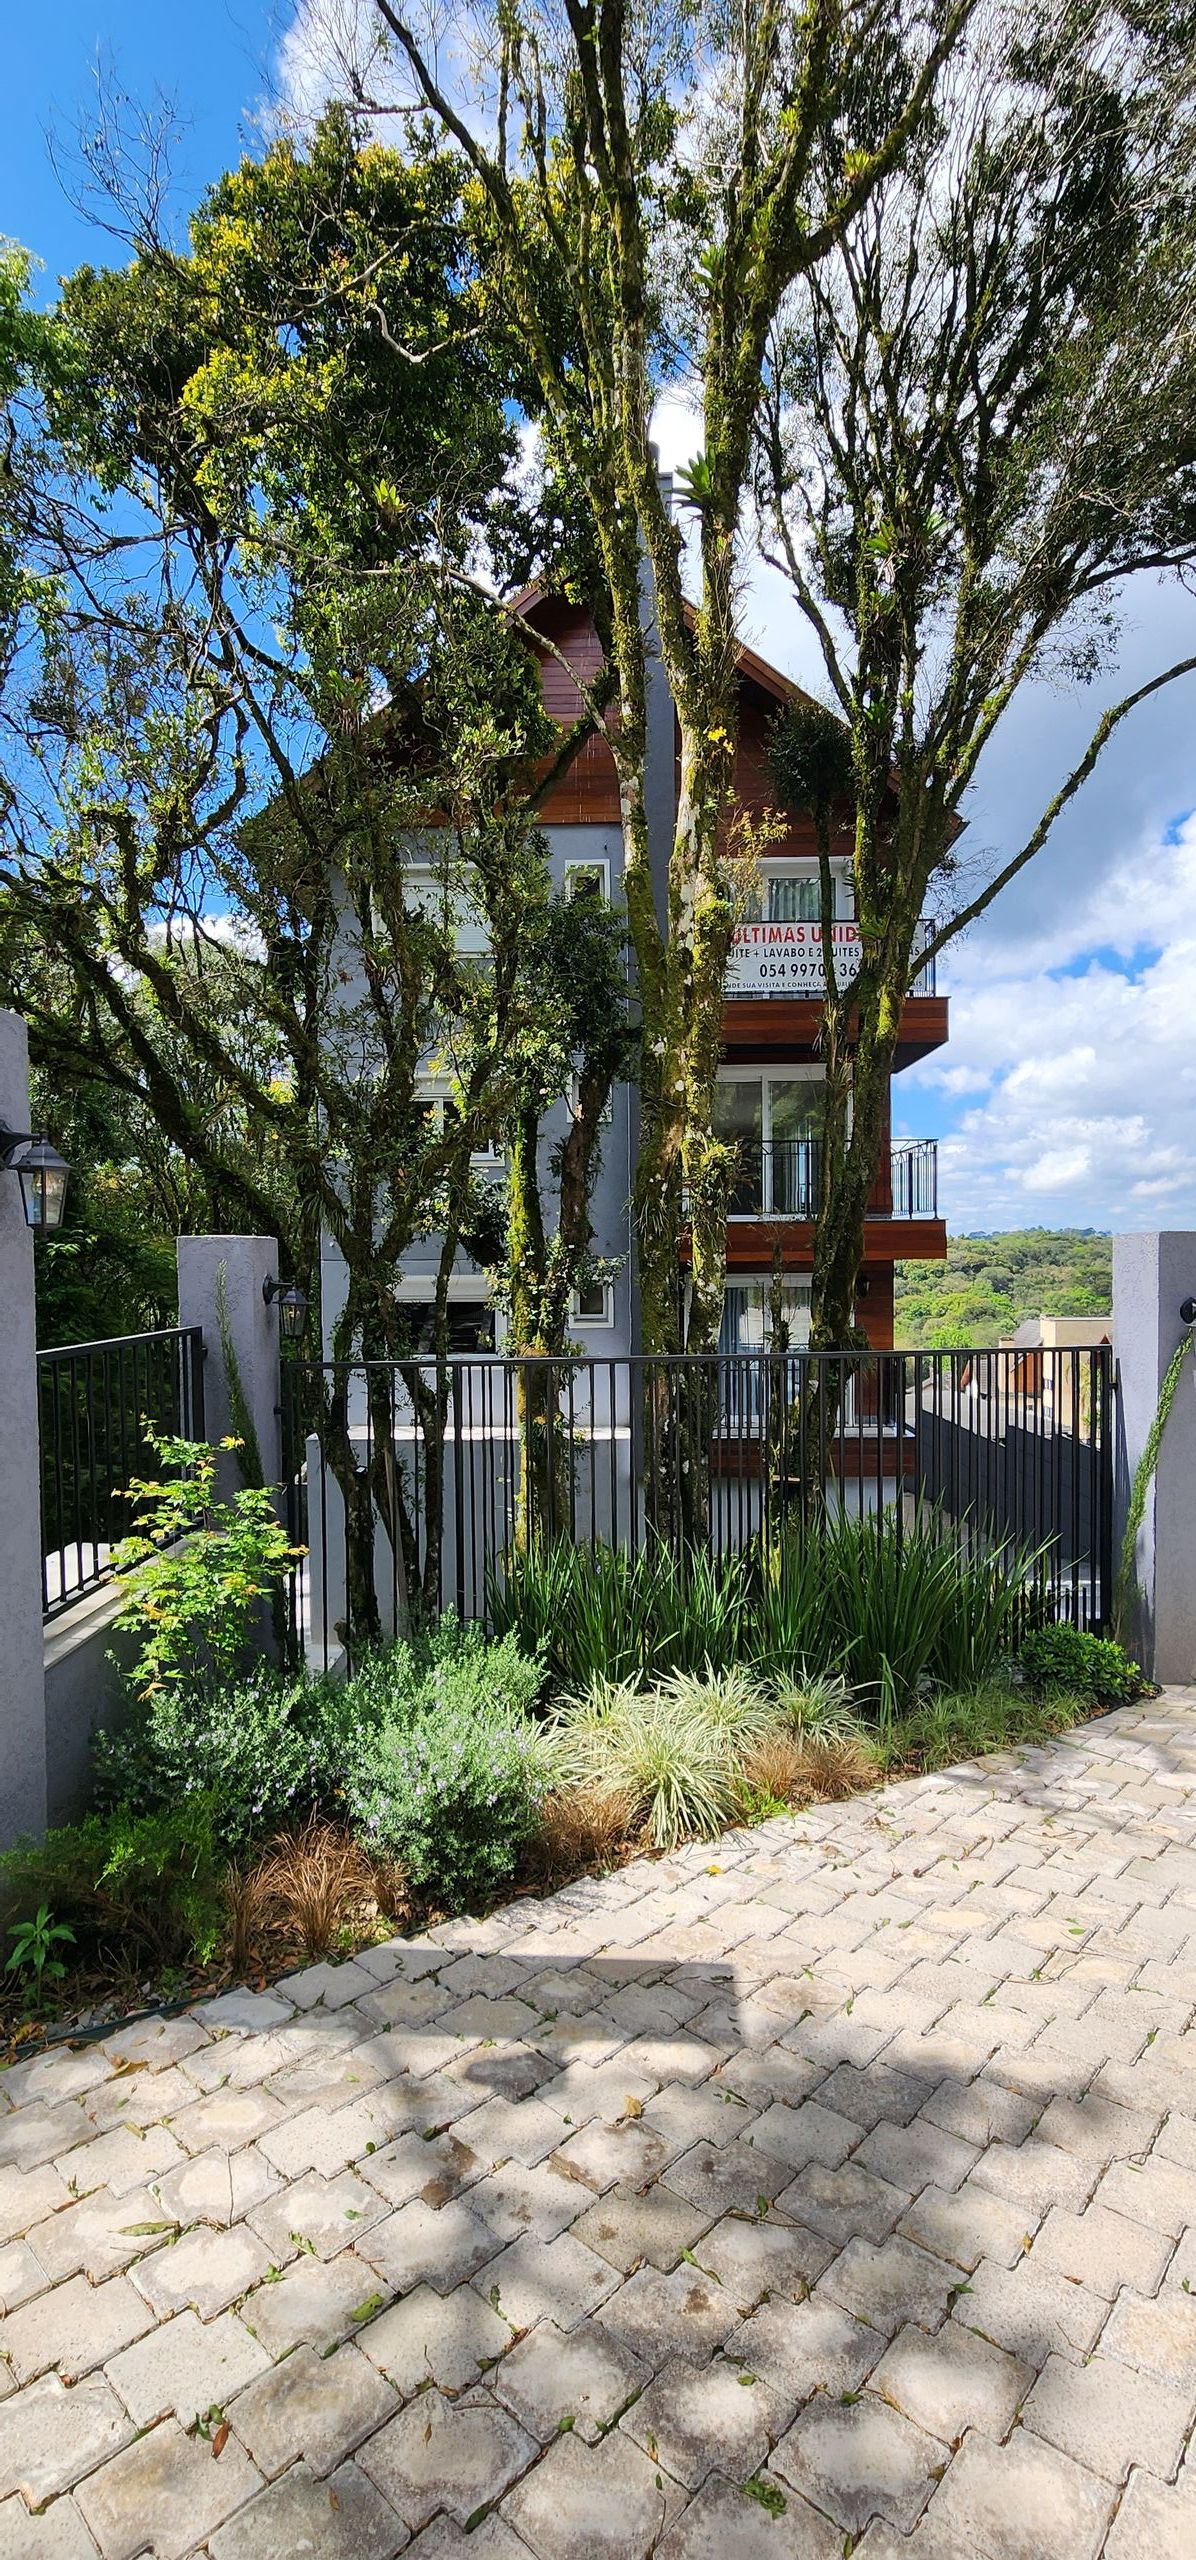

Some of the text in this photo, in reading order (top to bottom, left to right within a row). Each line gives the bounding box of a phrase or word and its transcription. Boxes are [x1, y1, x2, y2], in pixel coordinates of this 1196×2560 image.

[729, 948, 750, 958] UITE
[763, 947, 805, 958] LAVABO
[808, 948, 814, 957] E
[816, 947, 822, 957] 2
[832, 947, 860, 957] UITES
[759, 964, 786, 978] 054
[790, 963, 826, 977] 9970
